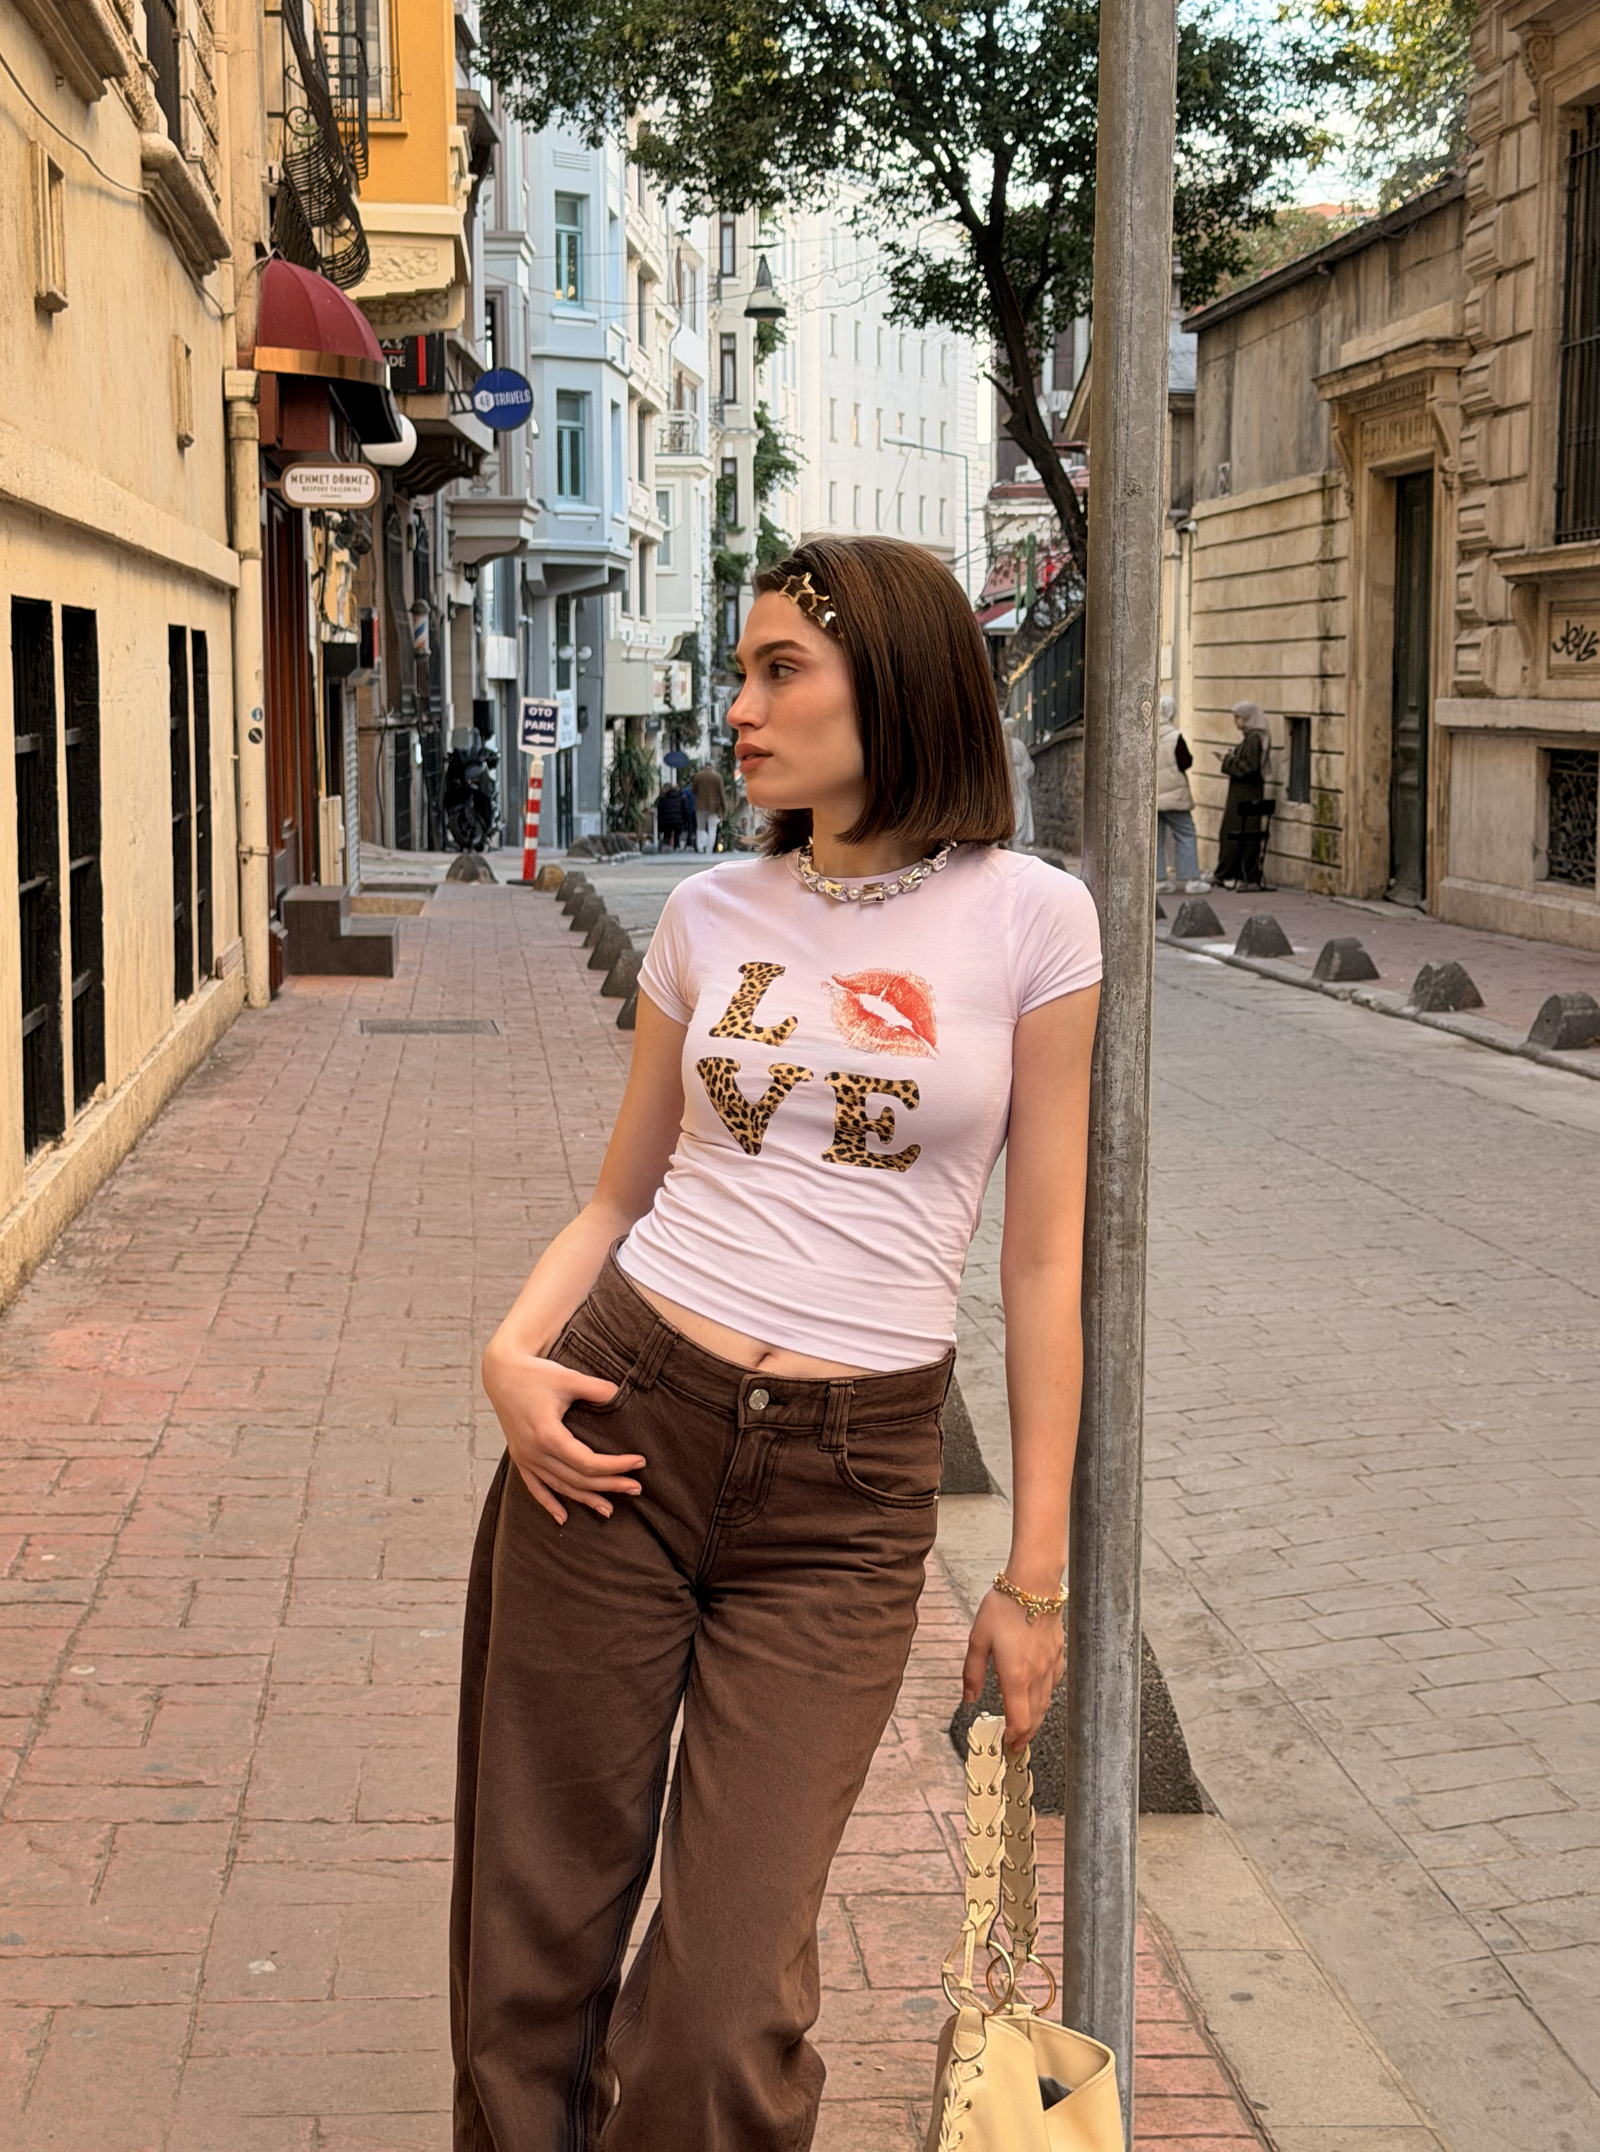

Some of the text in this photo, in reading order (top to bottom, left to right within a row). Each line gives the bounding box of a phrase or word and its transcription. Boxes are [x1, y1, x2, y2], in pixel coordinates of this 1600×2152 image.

[494, 388, 531, 407] TRAVELS
[290, 473, 330, 485] MEHMET
[528, 706, 553, 718] OTO
[524, 719, 555, 732] PARK
